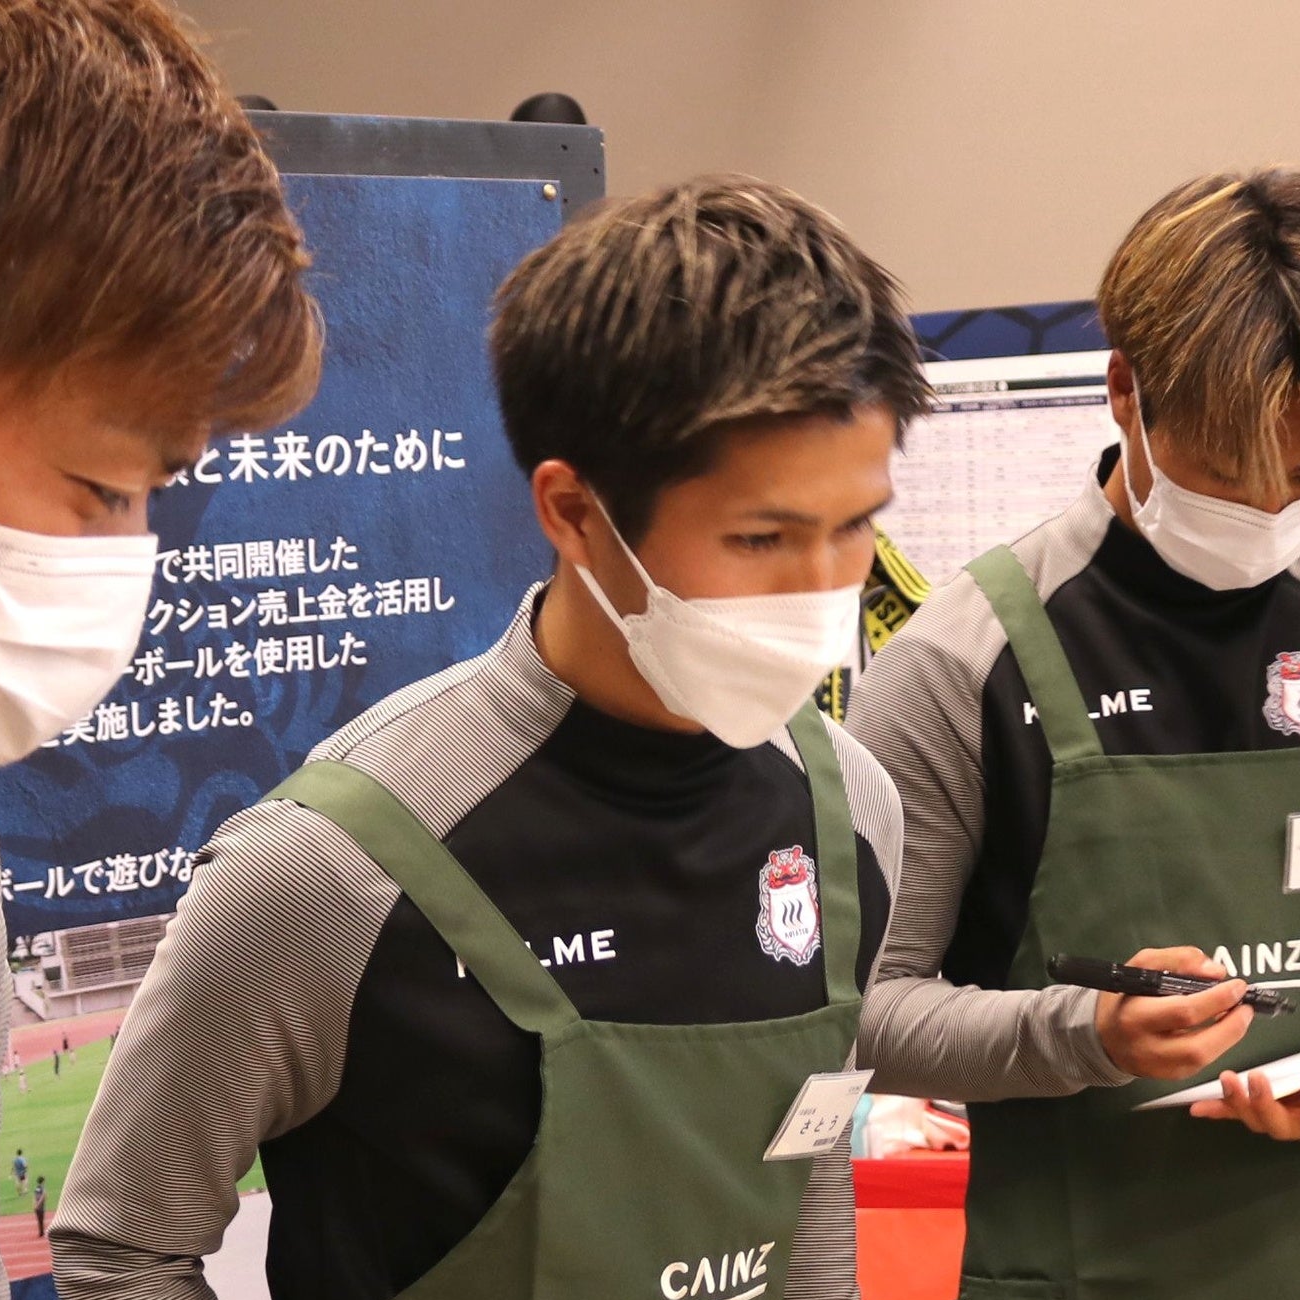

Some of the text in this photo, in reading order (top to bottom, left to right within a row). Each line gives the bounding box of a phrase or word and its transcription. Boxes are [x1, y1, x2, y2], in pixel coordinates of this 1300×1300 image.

[165, 428, 466, 487] と未来のために
[155, 537, 358, 583] で共同開催した
[800, 1115, 838, 1135] さとう
[660, 1241, 775, 1300] CAINZ
